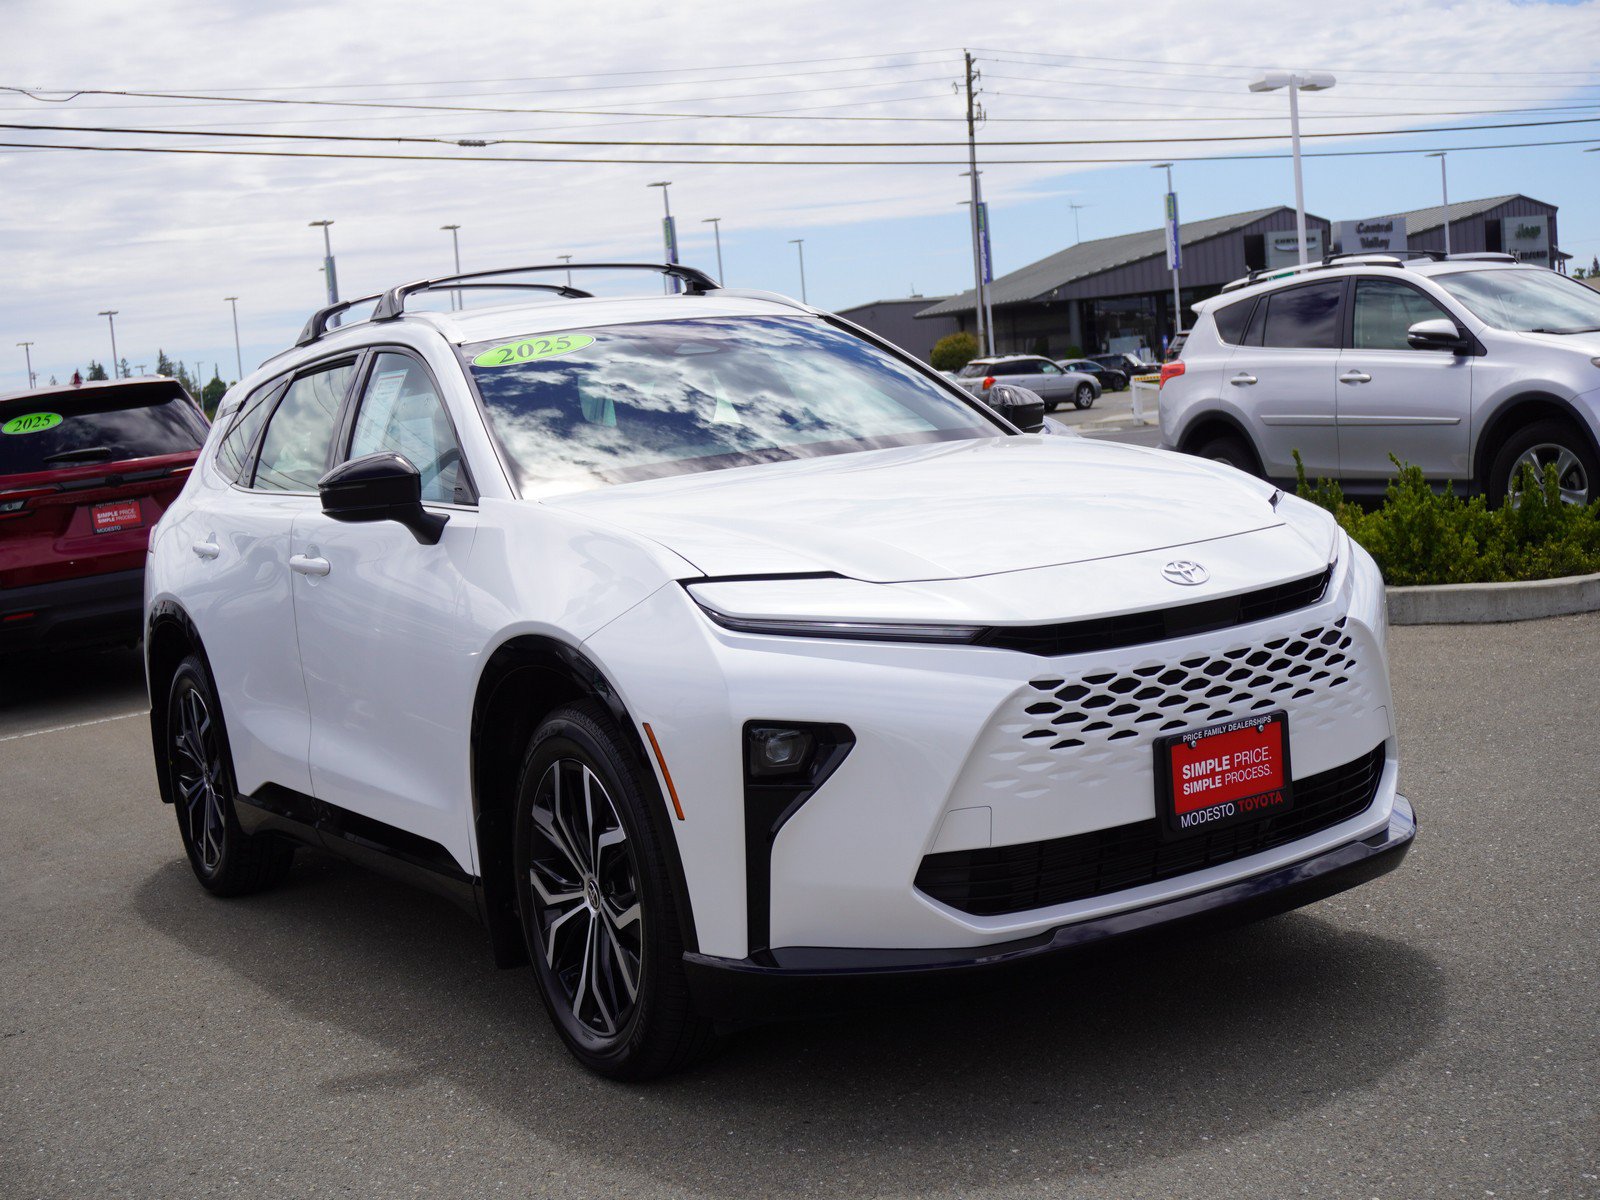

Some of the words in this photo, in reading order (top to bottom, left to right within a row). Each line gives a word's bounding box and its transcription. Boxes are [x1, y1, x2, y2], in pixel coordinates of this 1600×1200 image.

[1355, 221, 1393, 234] Central
[497, 335, 571, 364] 2025
[13, 415, 52, 432] 2025
[97, 510, 118, 519] SIMPLE
[97, 516, 115, 524] SIMPLE
[97, 525, 121, 533] MODESTO
[1182, 732, 1203, 743] PRICE
[1204, 725, 1227, 738] FAMILY
[1228, 715, 1272, 731] DEALERSHIPS
[1182, 755, 1231, 780] SIMPLE
[1234, 746, 1272, 767] PRICE.
[1183, 775, 1222, 795] SIMPLE
[1225, 764, 1273, 786] PROCESS.
[1180, 803, 1235, 828] MODESTO
[1237, 791, 1283, 812] TOYOTA
